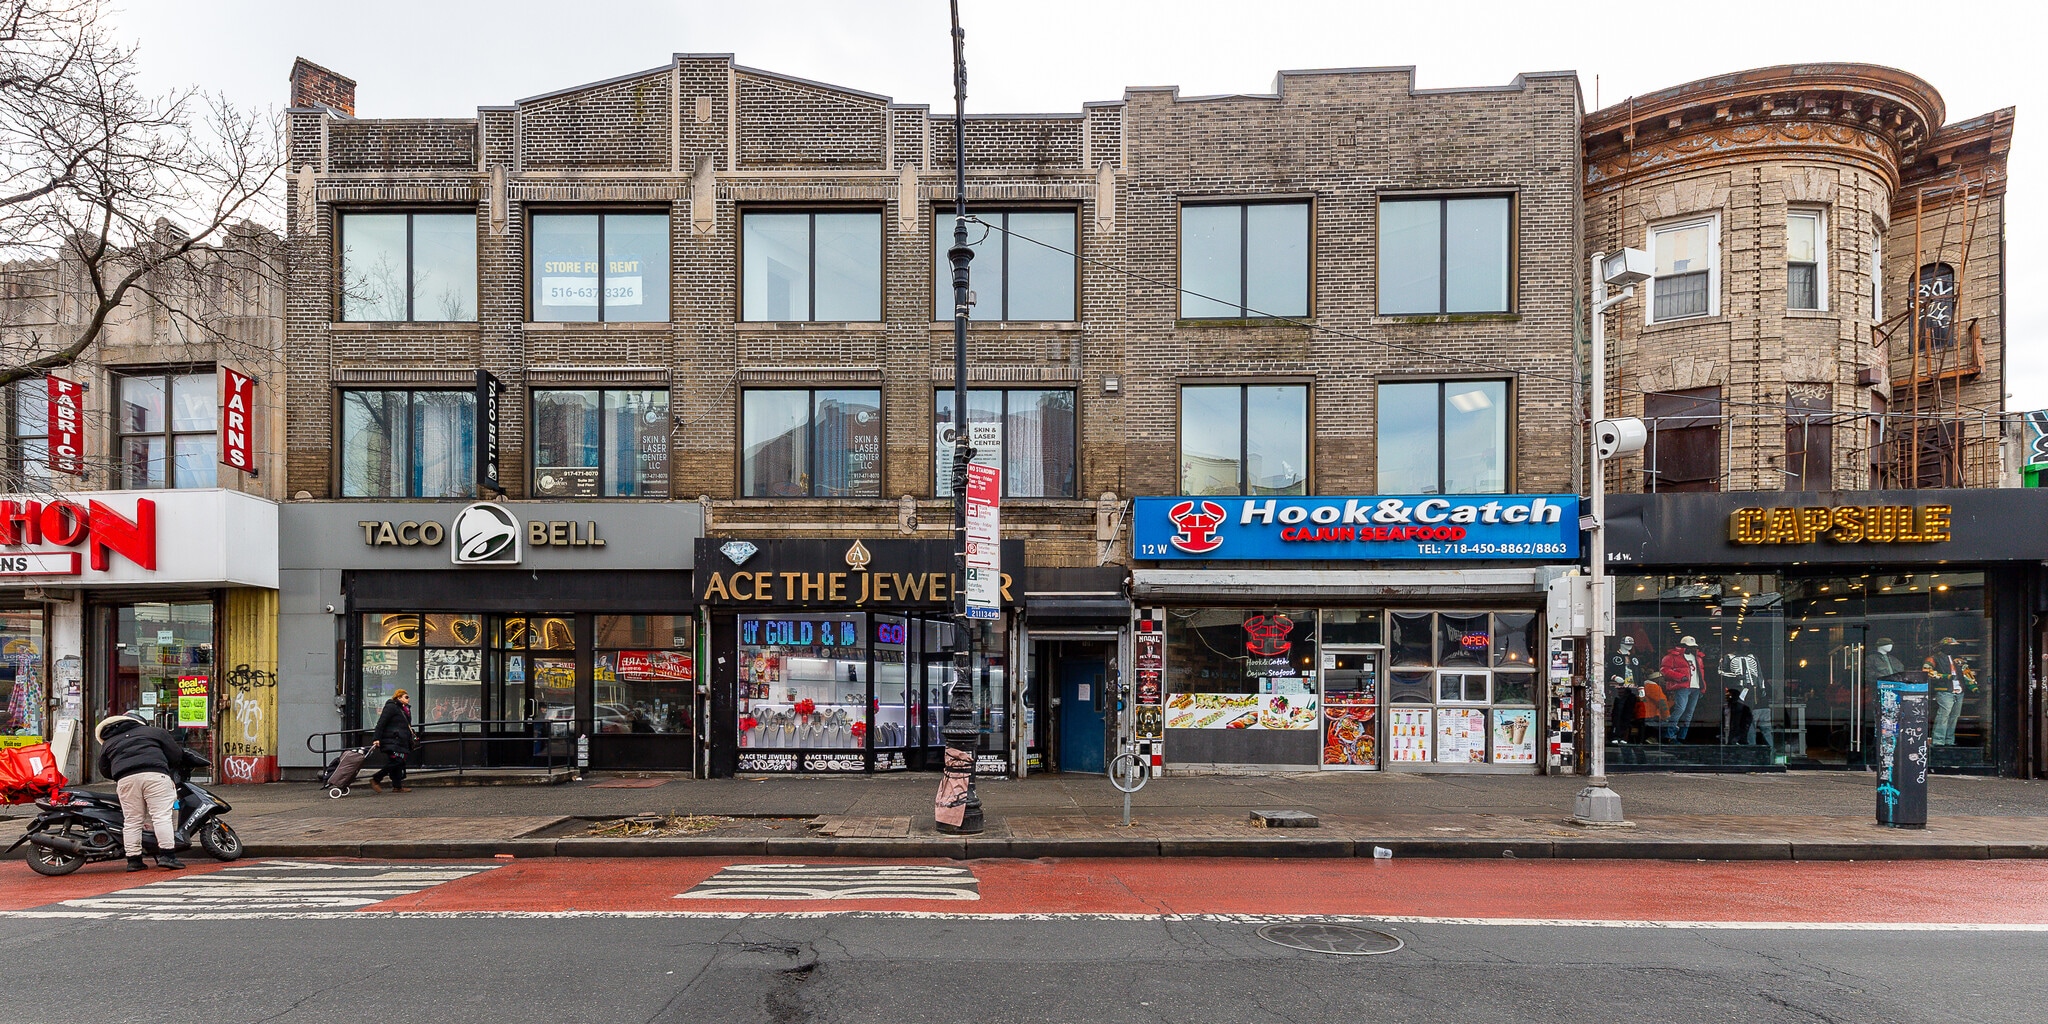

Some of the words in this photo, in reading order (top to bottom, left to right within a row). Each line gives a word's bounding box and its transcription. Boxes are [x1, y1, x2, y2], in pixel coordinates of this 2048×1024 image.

[545, 261, 581, 273] STORE
[584, 261, 600, 273] FO
[609, 261, 639, 273] RENT
[551, 287, 634, 298] 516-6373326
[488, 380, 496, 420] TACO
[228, 373, 247, 467] YARNS
[56, 381, 77, 471] FABRICS
[488, 421, 496, 461] BELL
[642, 435, 659, 443] SKIN
[854, 435, 871, 444] SKIN
[873, 435, 879, 444] &
[642, 444, 667, 453] LASER
[854, 444, 879, 453] LASER
[642, 453, 667, 461] CENTER
[854, 453, 880, 461] CENTER
[648, 461, 661, 470] LLC
[860, 461, 873, 470] LLC
[976, 467, 996, 476] STANDING
[1240, 498, 1562, 524] Hook&Catch
[1731, 504, 1952, 544] CAPSULE
[358, 520, 446, 546] TACO
[527, 520, 606, 546] BELL
[1280, 526, 1355, 542] CAJUN
[1359, 526, 1467, 542] SEAFOOD
[1141, 544, 1155, 555] 12
[1157, 544, 1168, 555] W
[1418, 544, 1441, 554] TEL:
[1444, 543, 1567, 555] 718-450-8862/8863
[1607, 552, 1622, 561] 14
[969, 569, 975, 580] 2
[703, 571, 773, 600] ACE
[780, 571, 847, 600] THE
[854, 571, 1014, 604] JEWER
[765, 621, 813, 645] GOLD
[821, 621, 834, 645] &
[1461, 635, 1490, 646] OPEN
[512, 657, 520, 667] A
[1246, 657, 1290, 666] Hook&Catch
[1268, 667, 1297, 678] Seafood
[178, 677, 198, 689] deal
[181, 684, 207, 696] week
